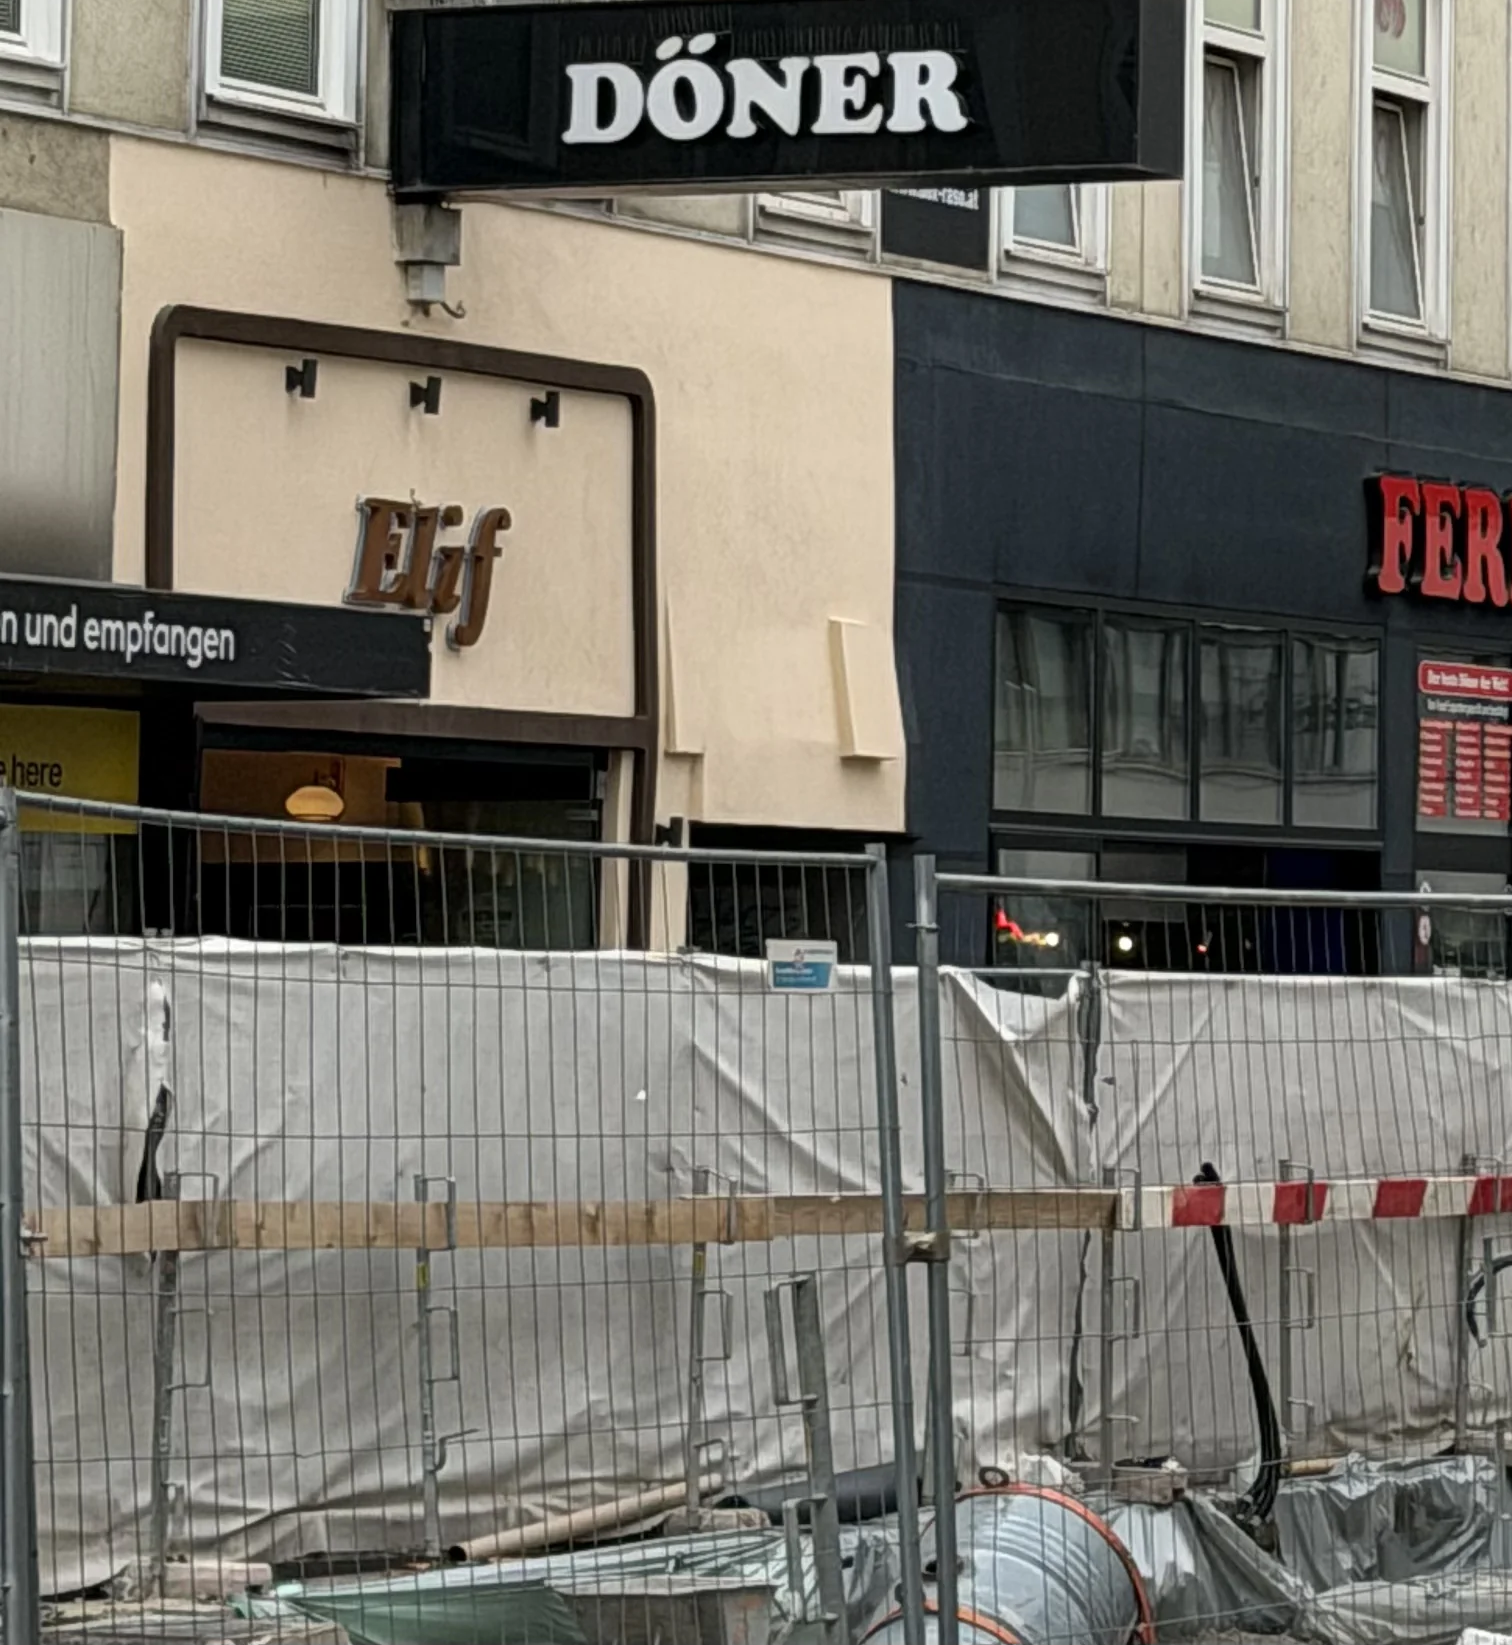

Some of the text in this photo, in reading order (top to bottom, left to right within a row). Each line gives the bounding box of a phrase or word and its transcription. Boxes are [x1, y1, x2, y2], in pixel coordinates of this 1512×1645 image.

[562, 32, 968, 144] DÖNER
[343, 496, 511, 650] Elif
[25, 603, 78, 648] und
[83, 610, 236, 669] empfangen
[12, 753, 63, 788] here
